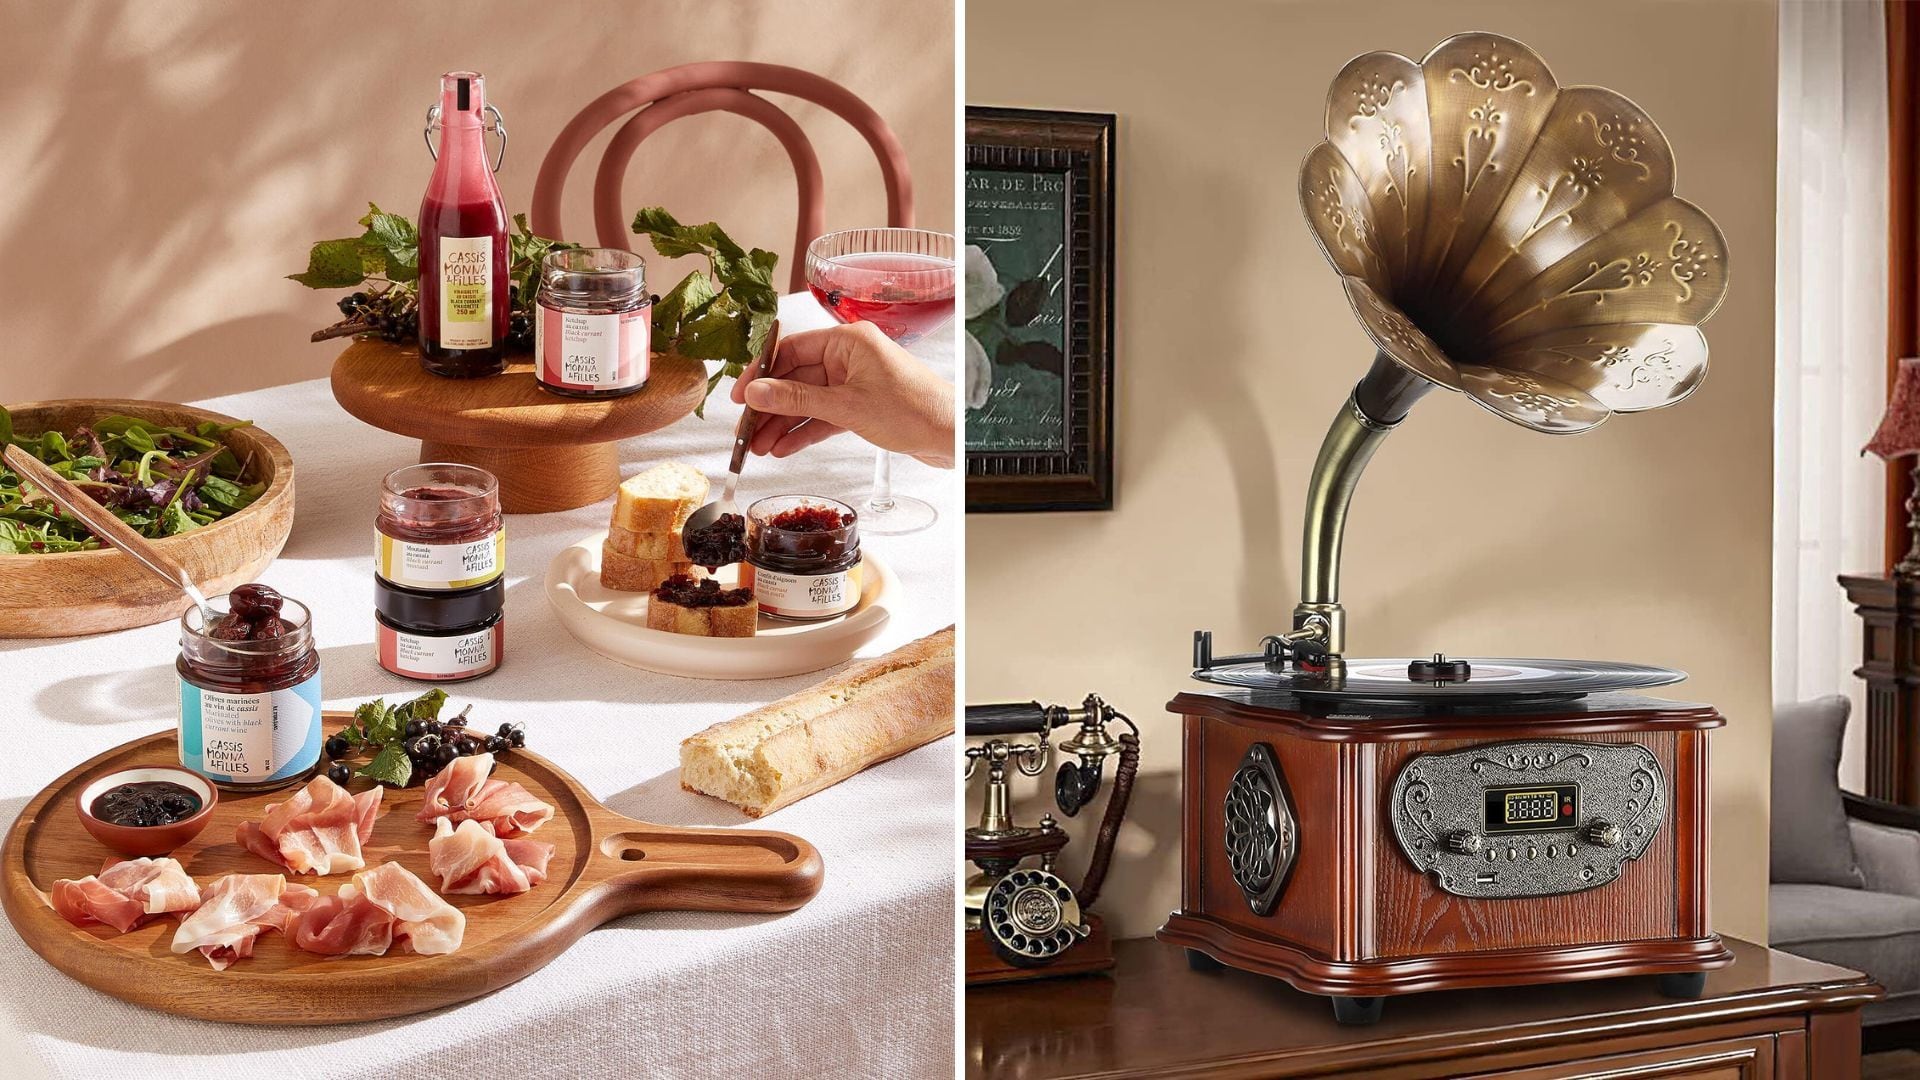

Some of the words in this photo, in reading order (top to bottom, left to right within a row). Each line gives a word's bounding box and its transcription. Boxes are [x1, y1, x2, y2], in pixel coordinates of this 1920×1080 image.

[1002, 178, 1026, 191] DE
[444, 262, 488, 275] MONNA
[565, 362, 597, 372] MONNA
[454, 643, 485, 658] MONNA
[204, 694, 225, 704] Olives
[213, 702, 225, 711] vin
[242, 718, 263, 726] black
[230, 726, 248, 734] wine
[206, 747, 245, 761] MONNA
